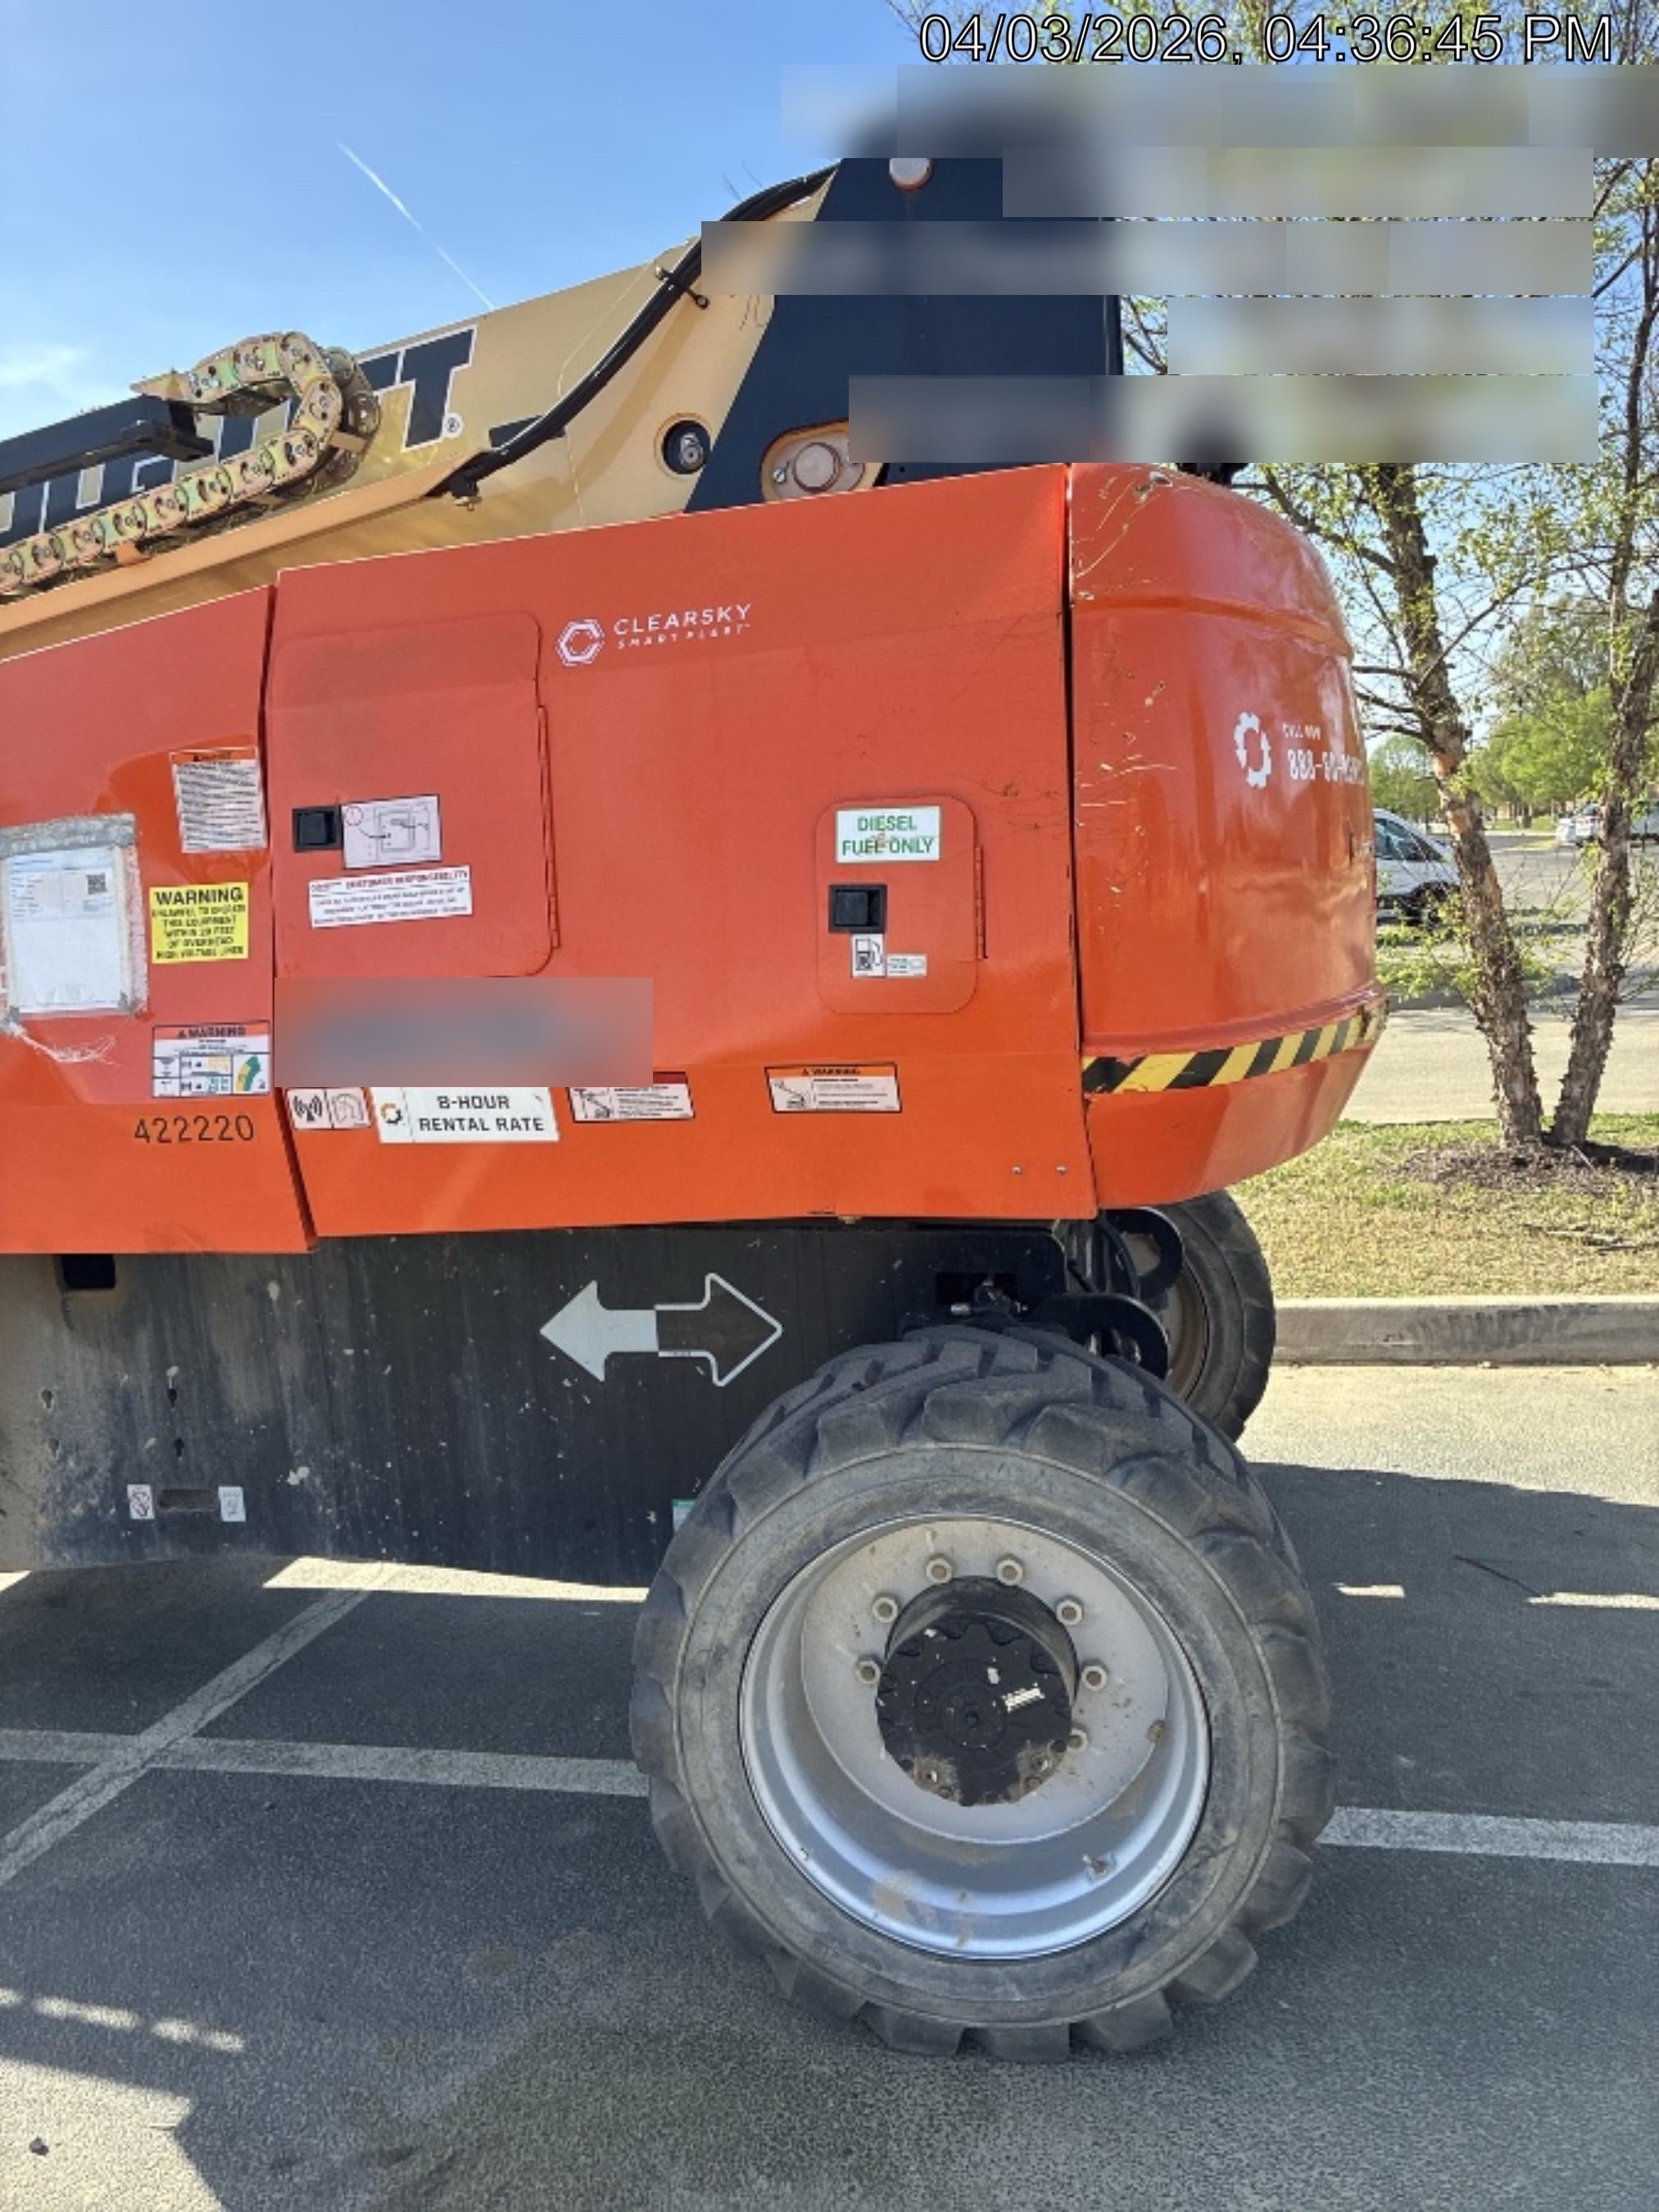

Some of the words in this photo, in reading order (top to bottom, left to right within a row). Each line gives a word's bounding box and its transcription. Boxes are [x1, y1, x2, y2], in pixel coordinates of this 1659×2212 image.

[614, 603, 751, 635] CLEARSKY
[857, 814, 917, 832] DIESEL
[842, 837, 886, 856] FUEL
[889, 836, 935, 854] ONLY
[154, 886, 243, 905] WARNING
[437, 1095, 510, 1109] 8-HOUR
[134, 1115, 254, 1144] 422220
[418, 1117, 490, 1131] RENTAL
[496, 1117, 544, 1131] RATE
